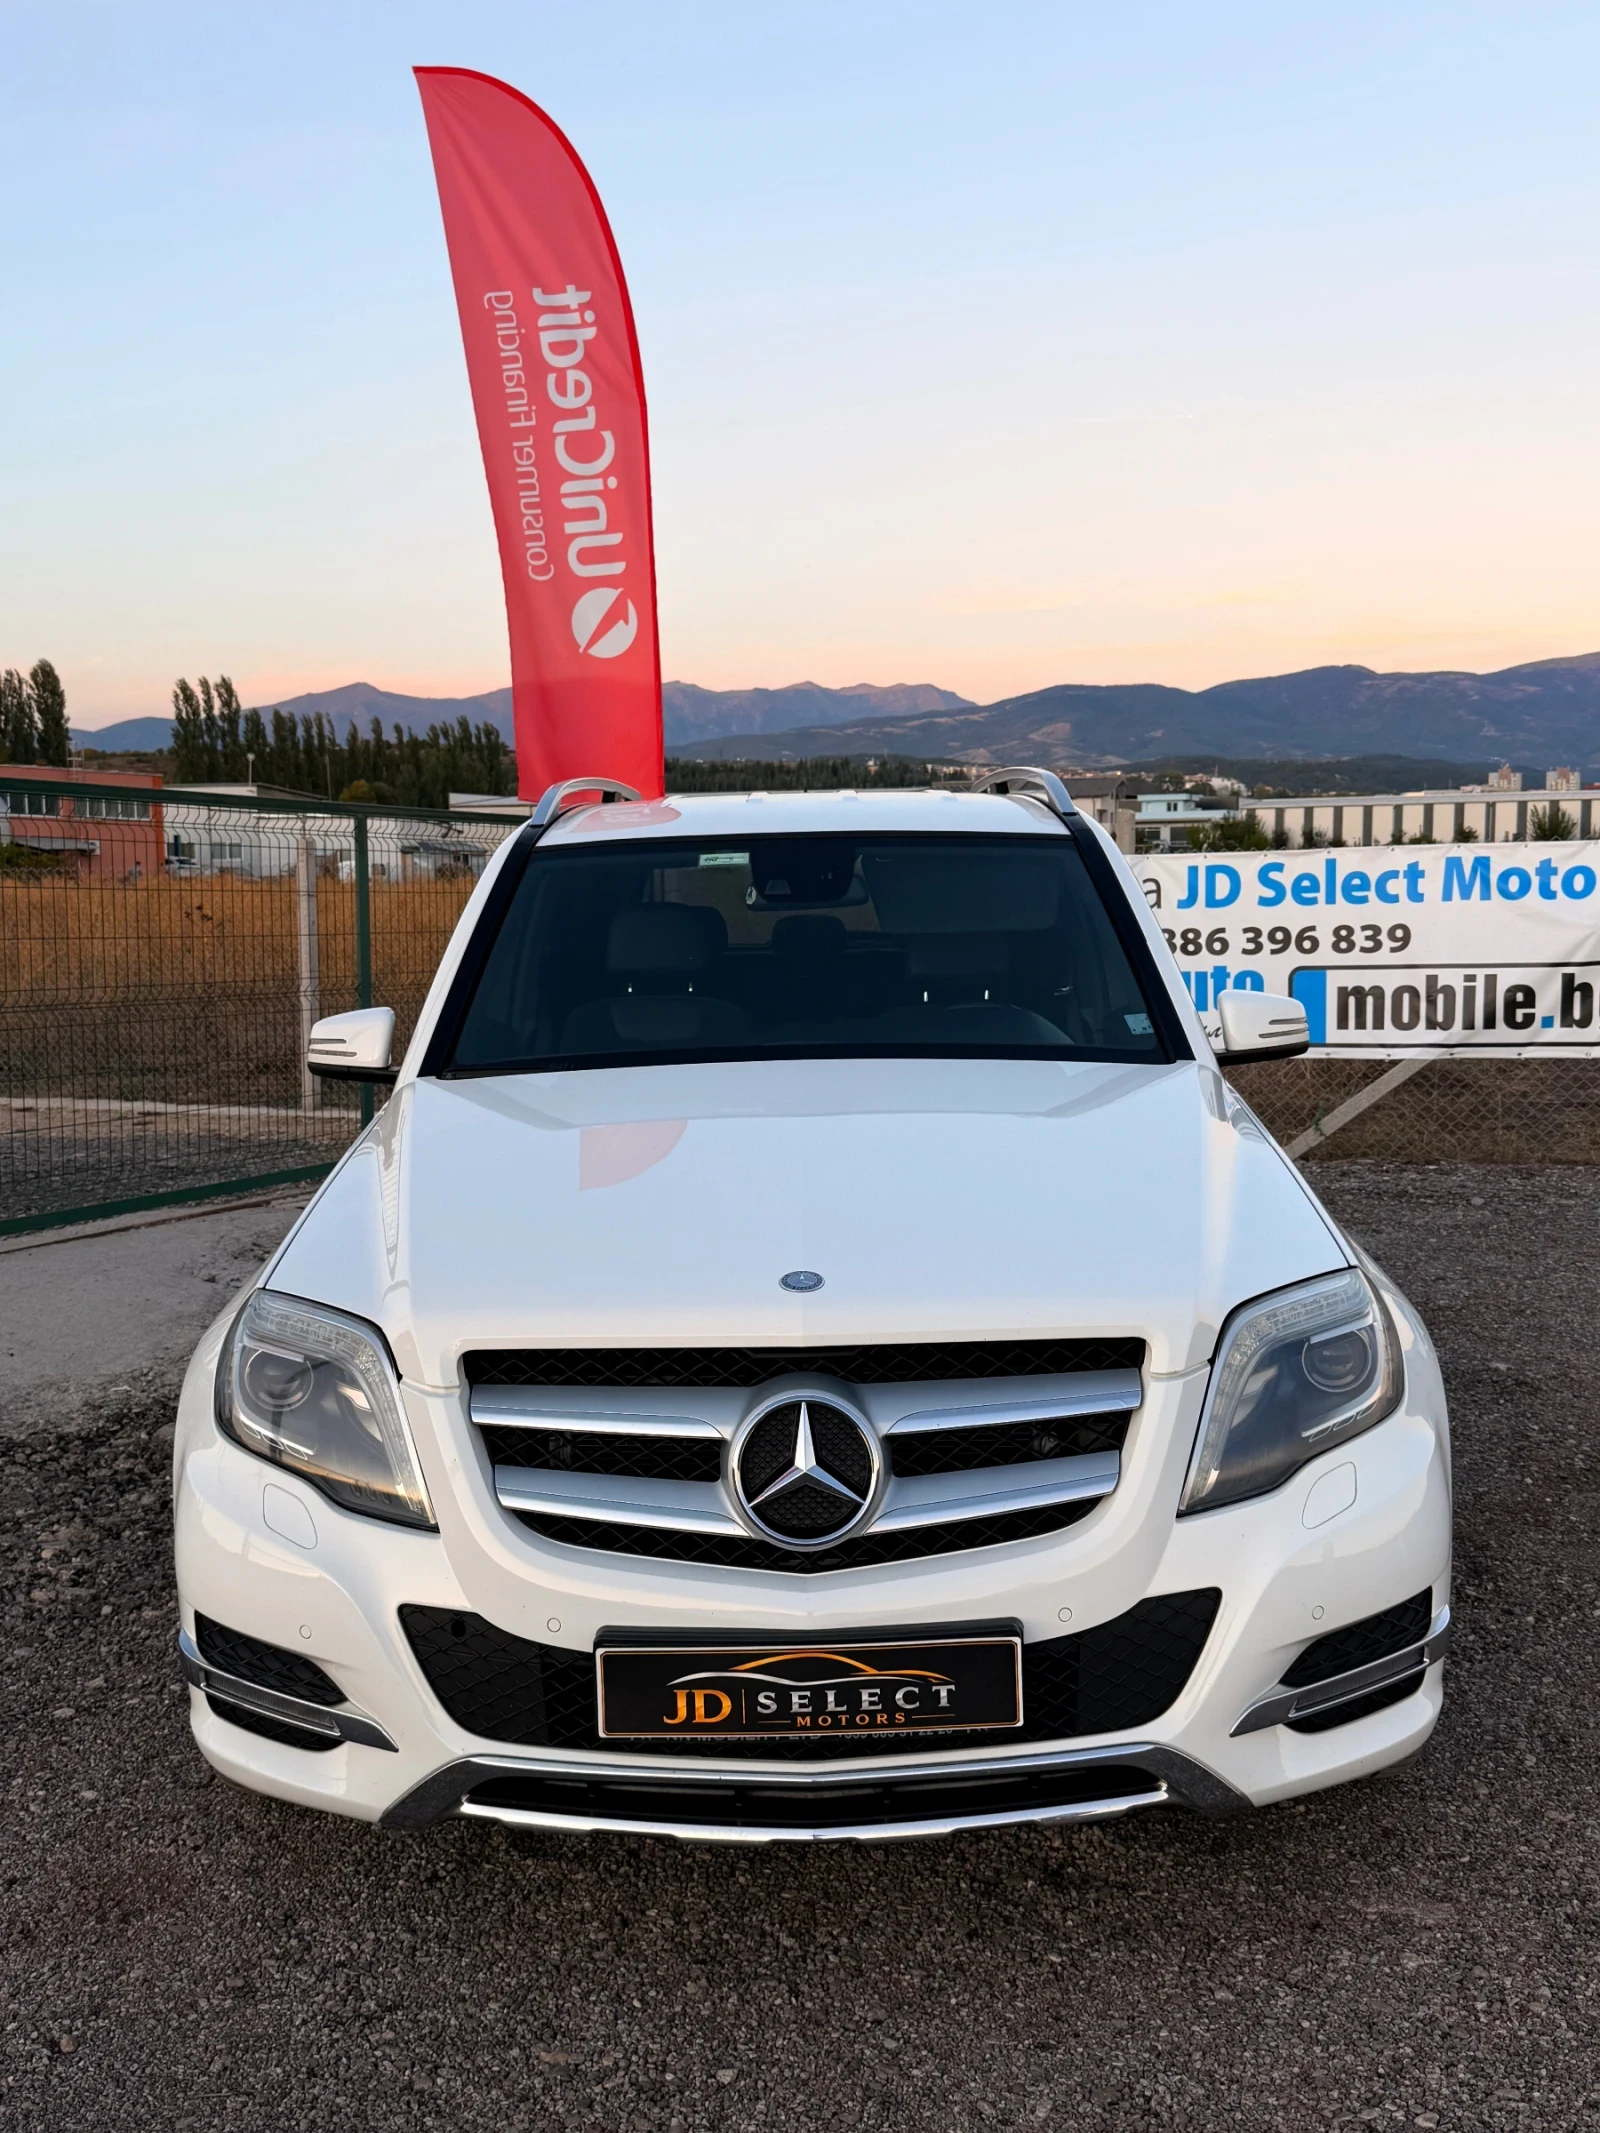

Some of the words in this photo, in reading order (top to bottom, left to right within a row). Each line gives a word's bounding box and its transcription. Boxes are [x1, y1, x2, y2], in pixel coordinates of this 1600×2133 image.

[1176, 865, 1242, 910] JD
[1257, 858, 1425, 908] Select
[1442, 855, 1597, 903] Moto
[1241, 925, 1320, 956] 396
[1331, 923, 1412, 954] 839
[1336, 972, 1600, 1032] mobile.b
[663, 1689, 732, 1724] JD
[757, 1684, 956, 1714] SELECT
[797, 1712, 906, 1727] MOTORS
